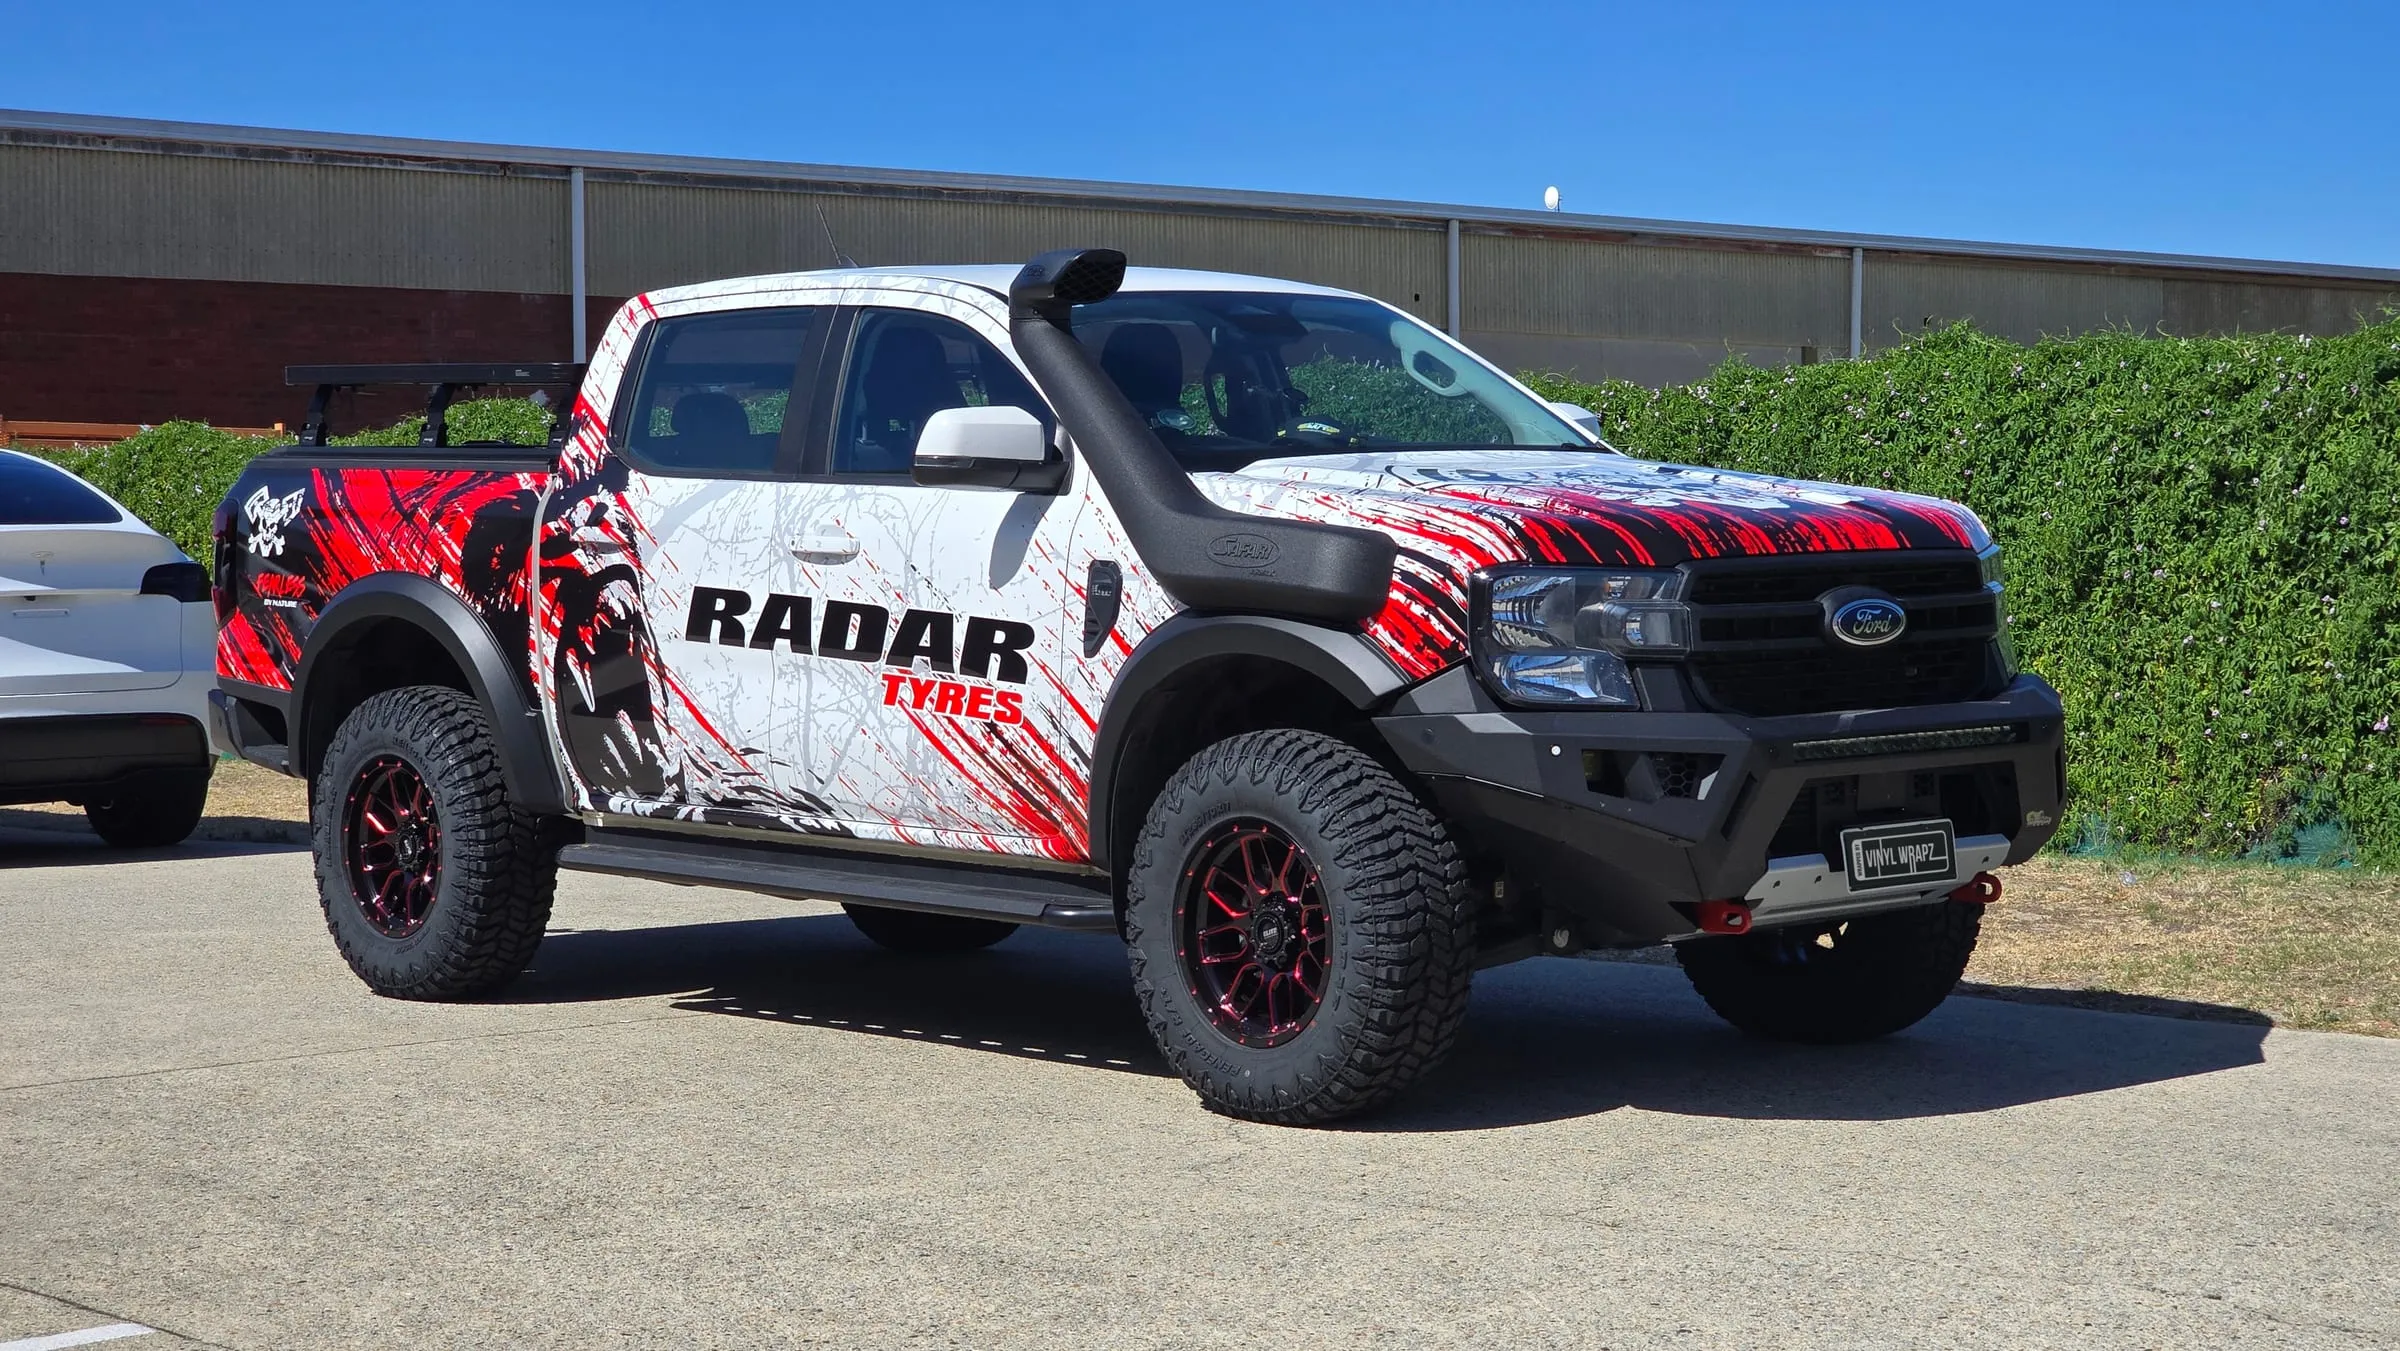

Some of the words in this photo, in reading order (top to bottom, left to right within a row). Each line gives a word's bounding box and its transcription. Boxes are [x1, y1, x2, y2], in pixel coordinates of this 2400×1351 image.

[1213, 538, 1275, 560] SAFARI
[1853, 609, 1892, 635] Ford
[686, 586, 1036, 685] RADAR
[881, 673, 1024, 725] TYRES
[1865, 847, 1897, 868] VINYL
[1898, 843, 1936, 866] WRAPZ
